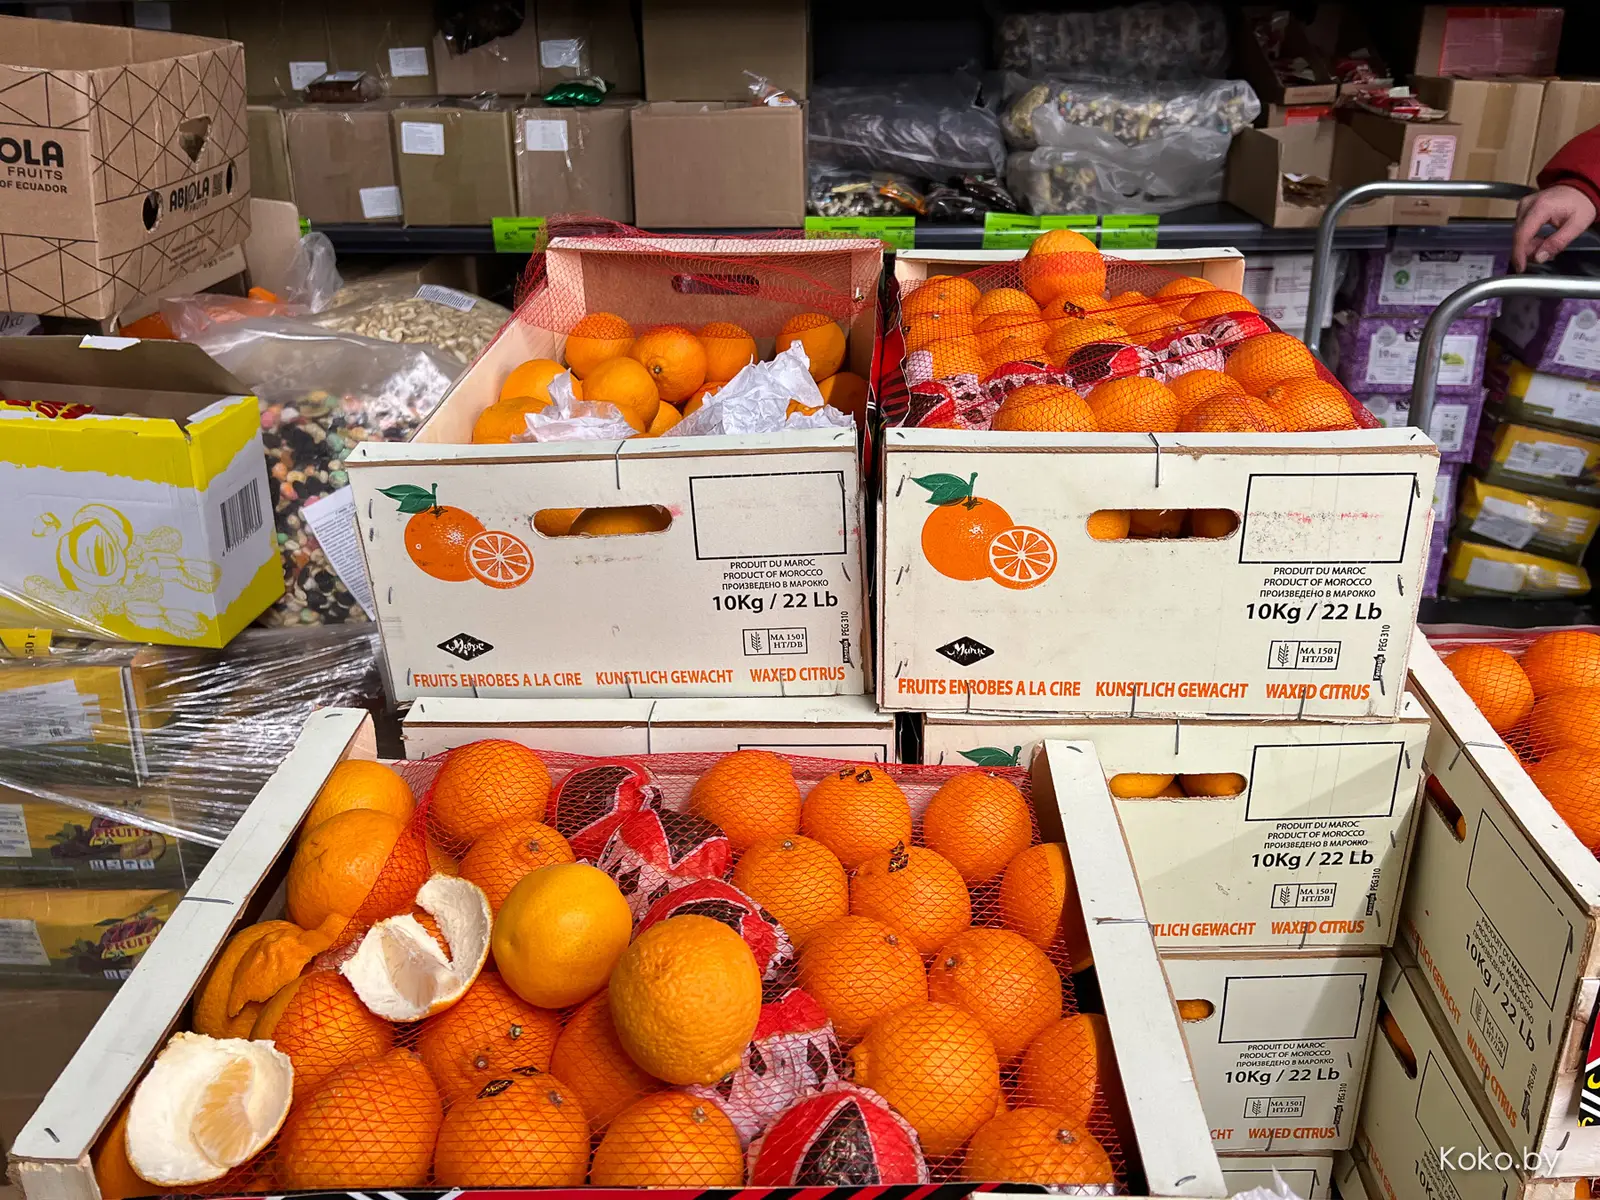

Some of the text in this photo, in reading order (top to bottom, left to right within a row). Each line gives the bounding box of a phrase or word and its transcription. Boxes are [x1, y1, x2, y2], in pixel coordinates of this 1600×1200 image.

[0, 137, 64, 168] OLA
[8, 166, 63, 180] FRUITS
[16, 181, 68, 193] ECUADOR
[169, 176, 210, 212] ABIOLA
[730, 559, 816, 569] PRODUIT DU MAROC
[1273, 567, 1366, 575] PRODUIT DU MAROC
[723, 569, 823, 580] PRODUCT OF MOROCCO
[1264, 578, 1372, 586] PRODUCT OF MOROCCO
[722, 579, 829, 590] ПРОИЗВЕДЕНО В МАРОККО
[1259, 590, 1324, 598] ПРОИЗВЕДЕНО
[1333, 590, 1376, 598] МАРОККО
[712, 591, 838, 613] 10Kg / 22 Lb
[1246, 602, 1382, 624] 10Kg / 22 Lb
[840, 610, 849, 636] PEG 310
[773, 641, 803, 649] HT/DB
[1377, 624, 1391, 651] PEG 310
[1317, 647, 1338, 655] 1501
[413, 672, 583, 688] FRUITS ENROBES A LA CIRE
[595, 669, 734, 686] KUNSTLICH GEWACHT
[750, 666, 846, 683] WAXED CITRUS
[898, 678, 1081, 696] FRUITS ENROBES A LA CIRE
[1095, 681, 1249, 698] KUNSTLICH GEWACHT
[1265, 683, 1370, 700] WAXED CITRUS
[1276, 822, 1313, 830] PRODUIT
[1267, 832, 1307, 840] PRODUCT
[1264, 841, 1321, 849] ПРОИЗВЕДЕНО
[1252, 850, 1374, 870] 10Kg / 22 Lb
[1370, 867, 1381, 891] PEG 310
[1192, 922, 1256, 936] GEWACHT
[1271, 920, 1365, 935] WAXED CITRUS
[1466, 934, 1535, 1052] 10Kg / 22 Lb
[1236, 1060, 1290, 1068] ПРОИЗВЕДЕНО
[1225, 1067, 1340, 1085] 10Kg / 22 Lb
[1467, 1029, 1518, 1129] WAXED CITRUS
[1248, 1127, 1336, 1138] WAXED CITRUS
